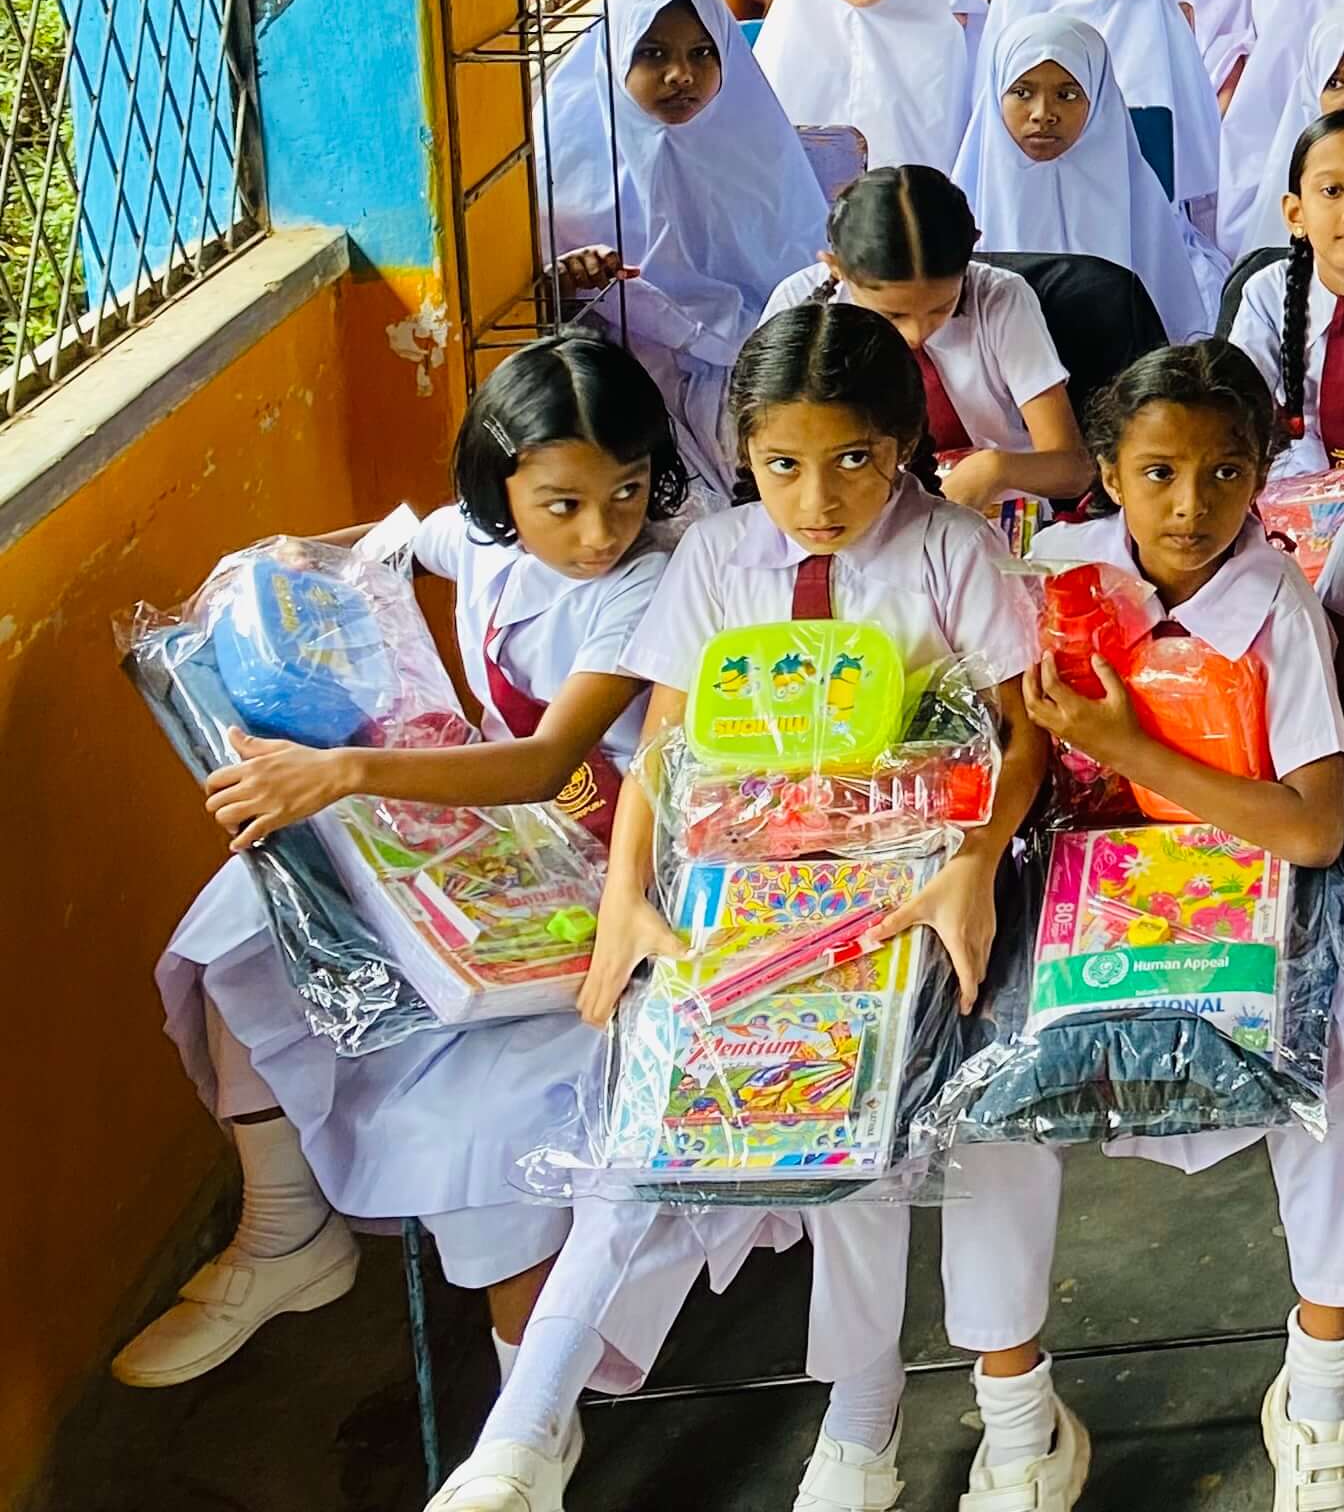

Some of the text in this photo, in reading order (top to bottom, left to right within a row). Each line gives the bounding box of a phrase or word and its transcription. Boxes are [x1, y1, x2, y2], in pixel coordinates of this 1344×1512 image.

[1054, 902, 1075, 922] 80
[1133, 956, 1230, 973] Human Appeal
[686, 1037, 801, 1065] Pentium
